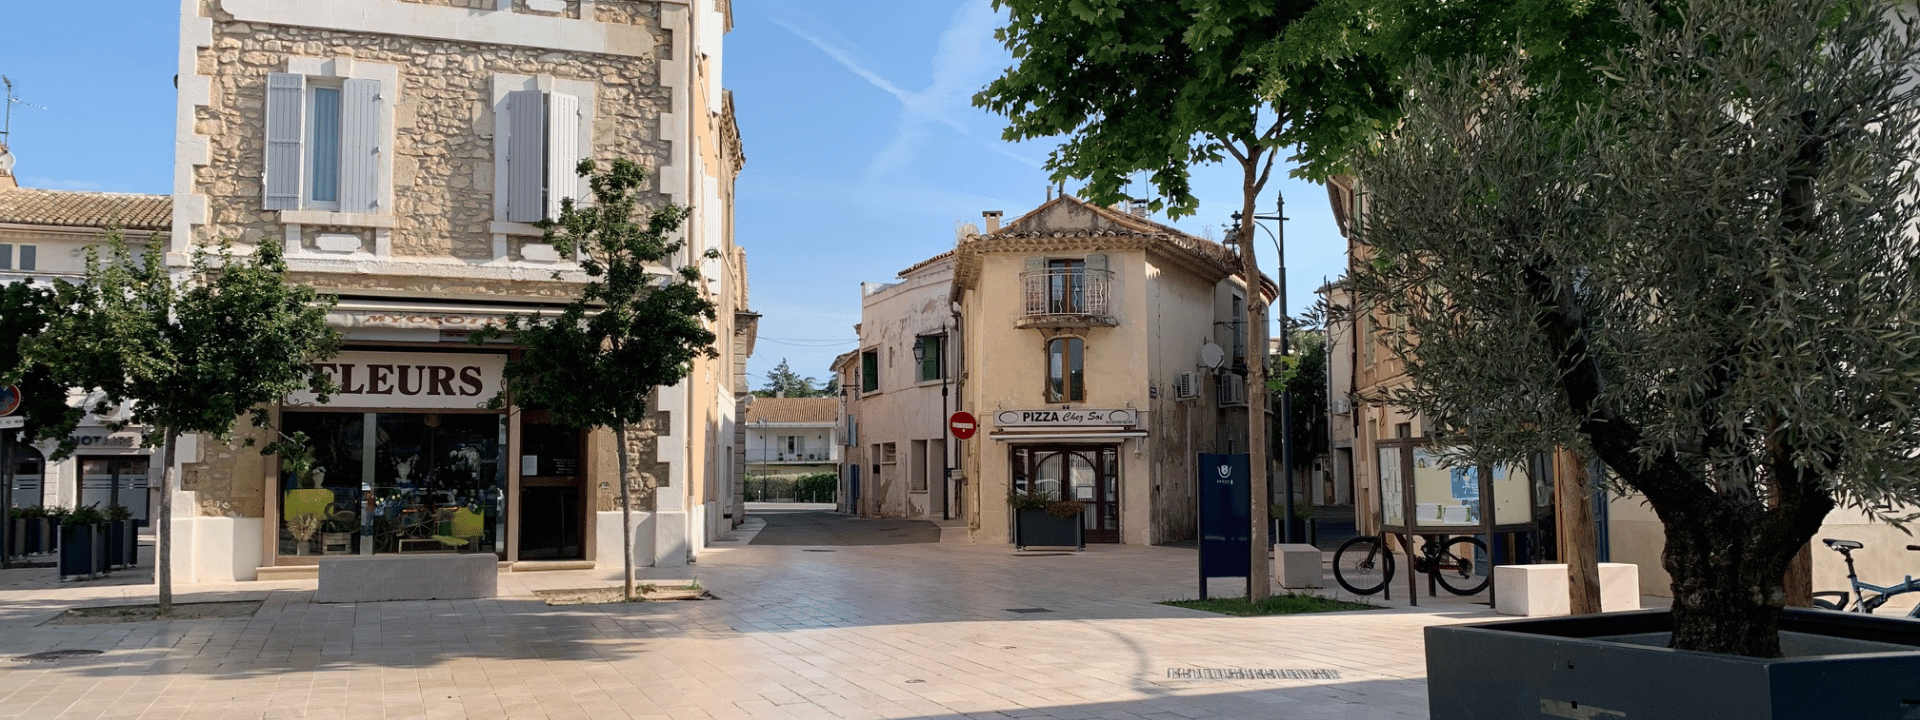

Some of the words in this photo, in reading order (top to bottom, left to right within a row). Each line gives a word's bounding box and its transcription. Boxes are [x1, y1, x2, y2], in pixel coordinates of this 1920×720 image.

[310, 363, 483, 397] FLEURS
[1022, 411, 1059, 422] PIZZA
[1062, 411, 1084, 423] Chez
[1087, 411, 1104, 421] Soi
